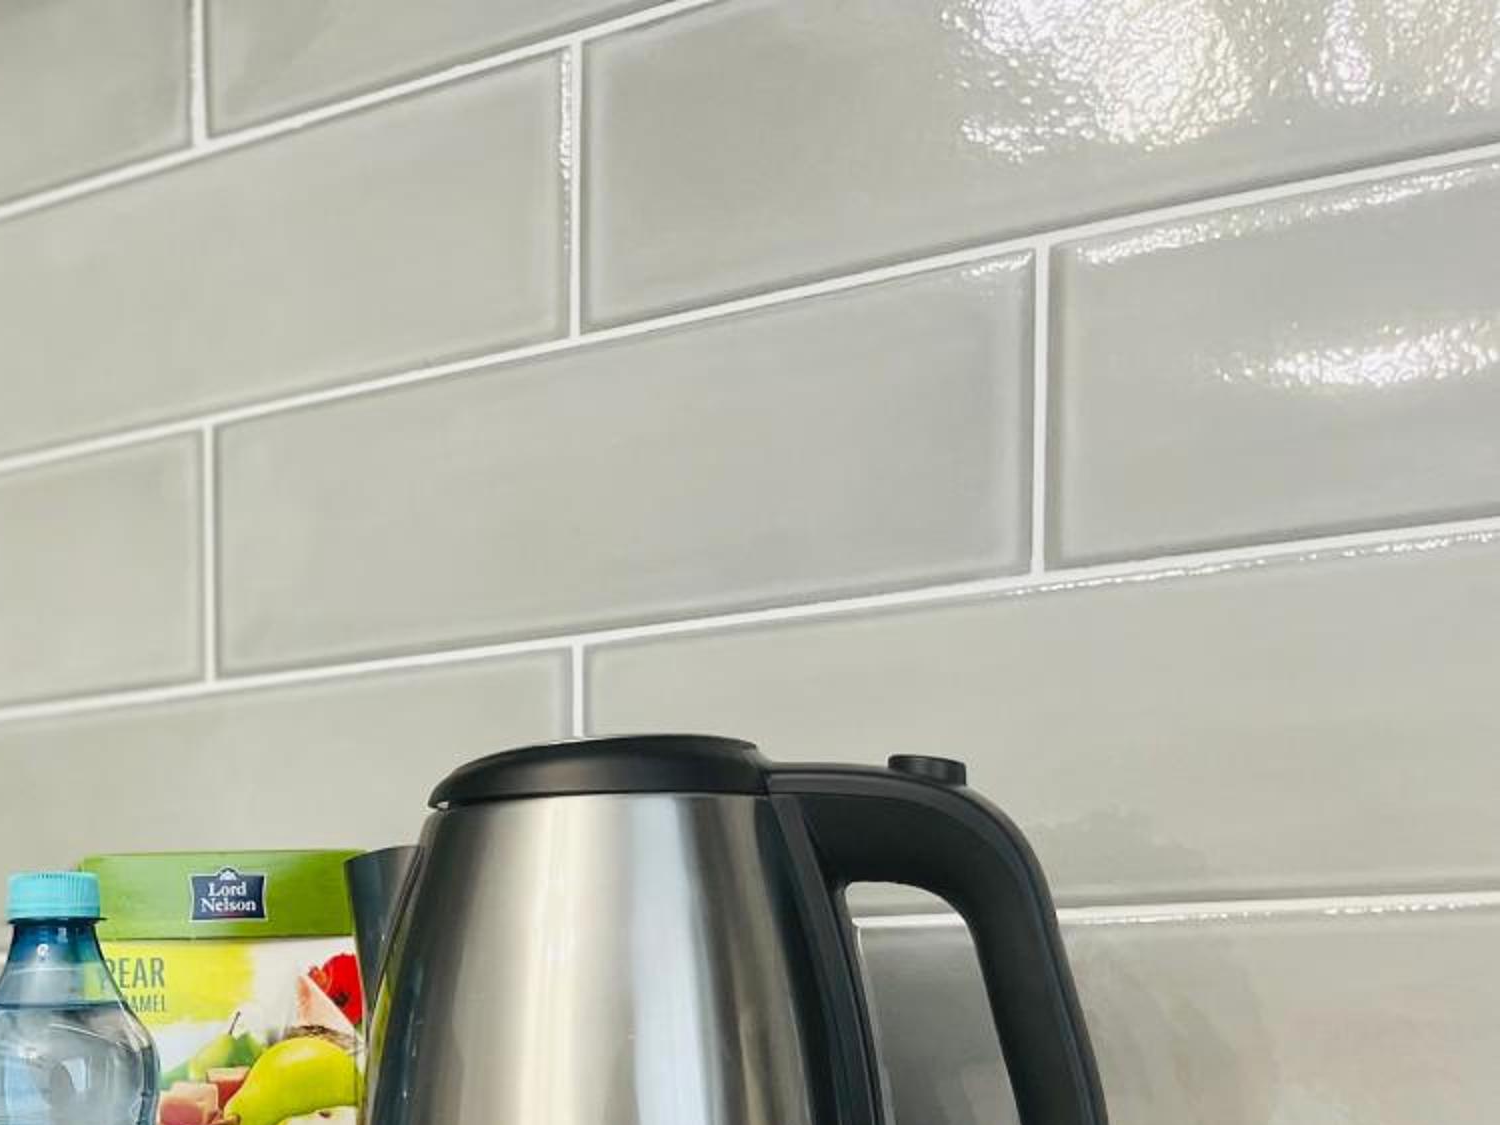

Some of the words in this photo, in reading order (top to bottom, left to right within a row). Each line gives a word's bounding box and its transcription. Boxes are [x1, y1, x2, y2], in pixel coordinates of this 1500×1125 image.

[208, 881, 247, 898] Lord
[200, 897, 257, 913] Nelson
[129, 994, 165, 1013] AMEL
